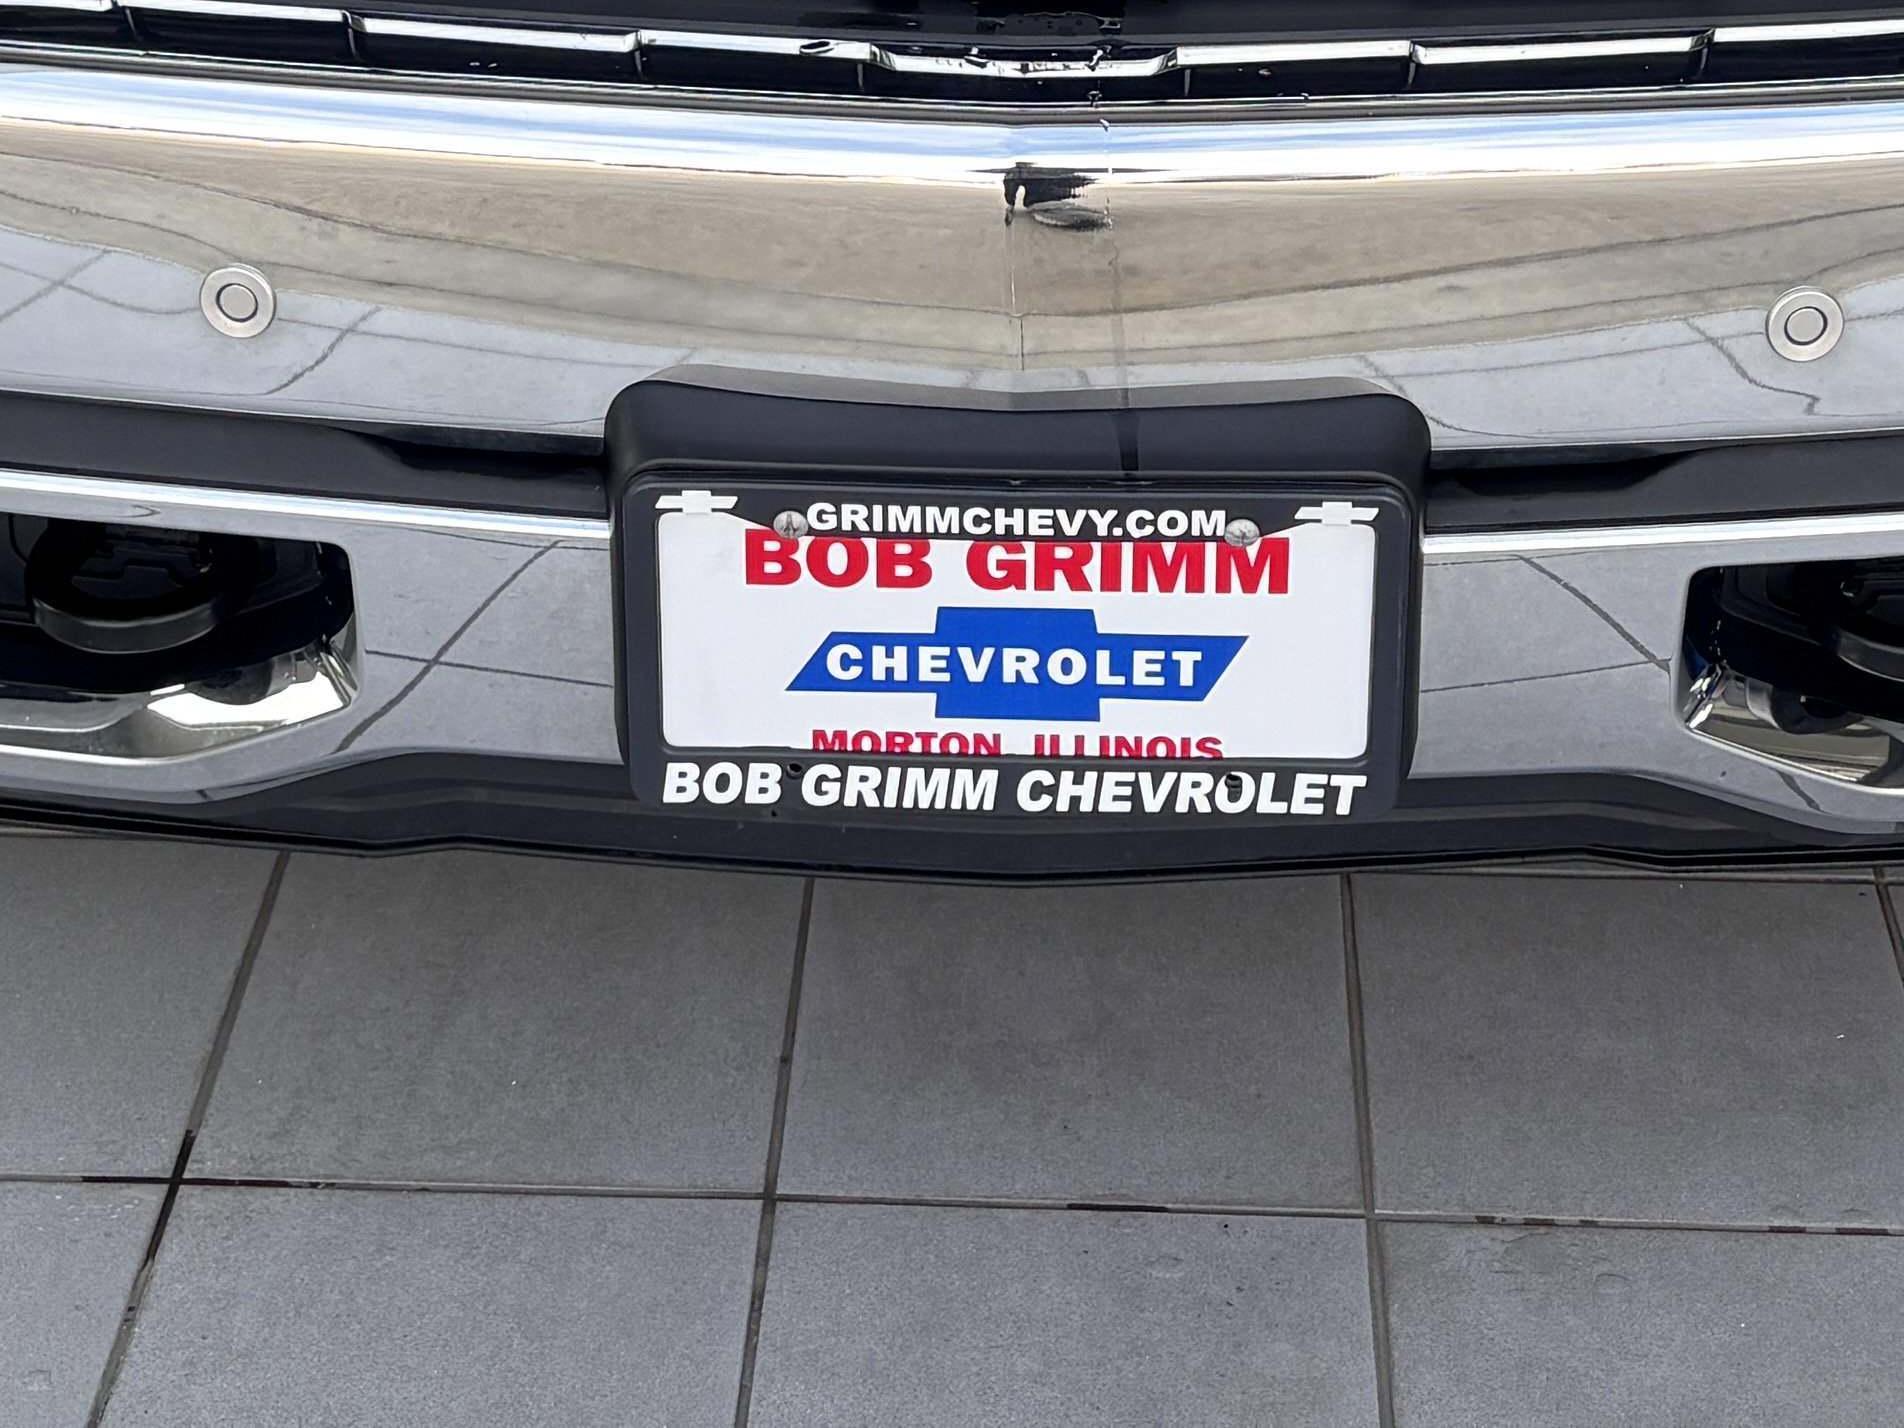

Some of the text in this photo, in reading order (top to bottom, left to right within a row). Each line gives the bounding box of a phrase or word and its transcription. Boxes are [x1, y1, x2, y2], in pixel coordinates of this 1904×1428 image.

[806, 502, 1226, 537] GRIMMCHEVY.COM
[745, 529, 1290, 594] BOB GRIMM
[826, 644, 1202, 687] CHEVROLET
[662, 761, 1368, 816] BOB GRIMM CHEVROLET
